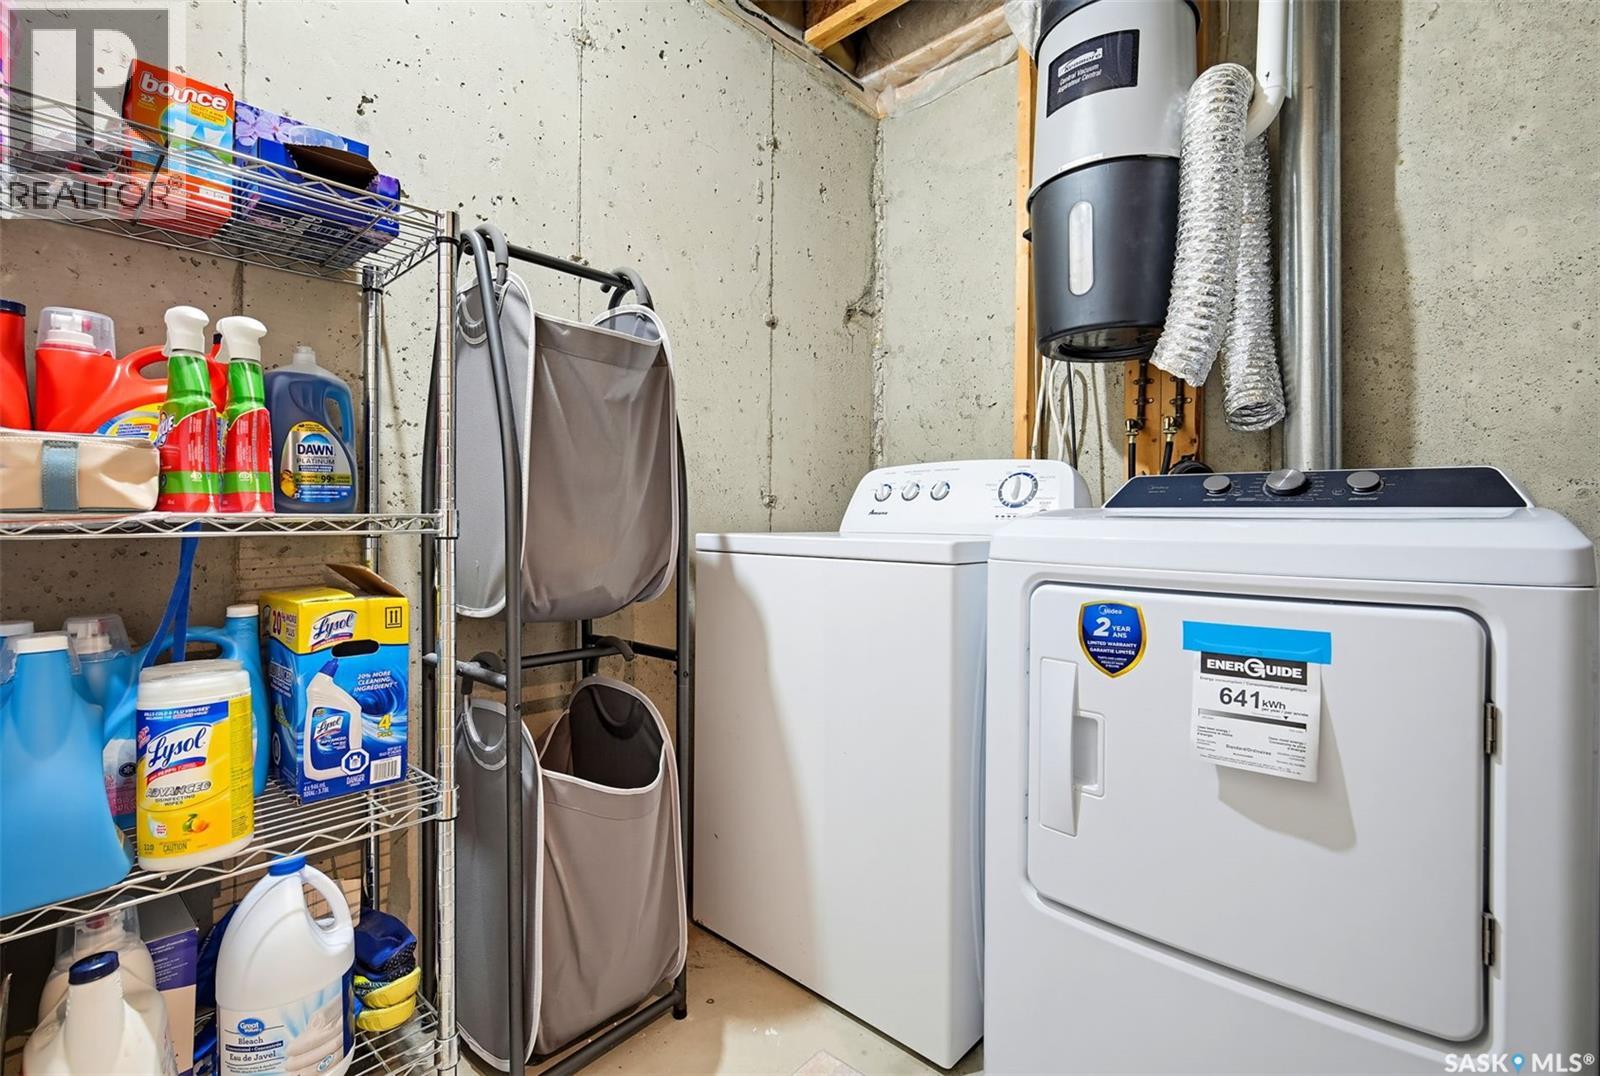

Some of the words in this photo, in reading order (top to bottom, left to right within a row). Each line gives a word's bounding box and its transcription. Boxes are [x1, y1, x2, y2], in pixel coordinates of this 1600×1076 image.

[1077, 63, 1100, 77] Vacuum
[140, 71, 228, 111] bounce
[297, 444, 334, 455] DAWN
[296, 457, 336, 465] PLATINUM
[312, 612, 355, 640] Lysol
[1093, 616, 1111, 637] 2
[372, 670, 391, 678] MORE
[357, 678, 391, 686] CLEANING
[1219, 687, 1260, 709] 641
[1262, 700, 1286, 710] kWh
[316, 716, 341, 735] Lysol
[379, 714, 391, 730] 4
[148, 727, 207, 768] Lysol
[146, 780, 212, 798] ADVANCED
[163, 842, 187, 853] CAUTION
[240, 1020, 259, 1029] Great
[238, 1036, 264, 1044] Bleach
[229, 1053, 242, 1061] Eau
[243, 1054, 252, 1062] de
[254, 1050, 276, 1061] Javel
